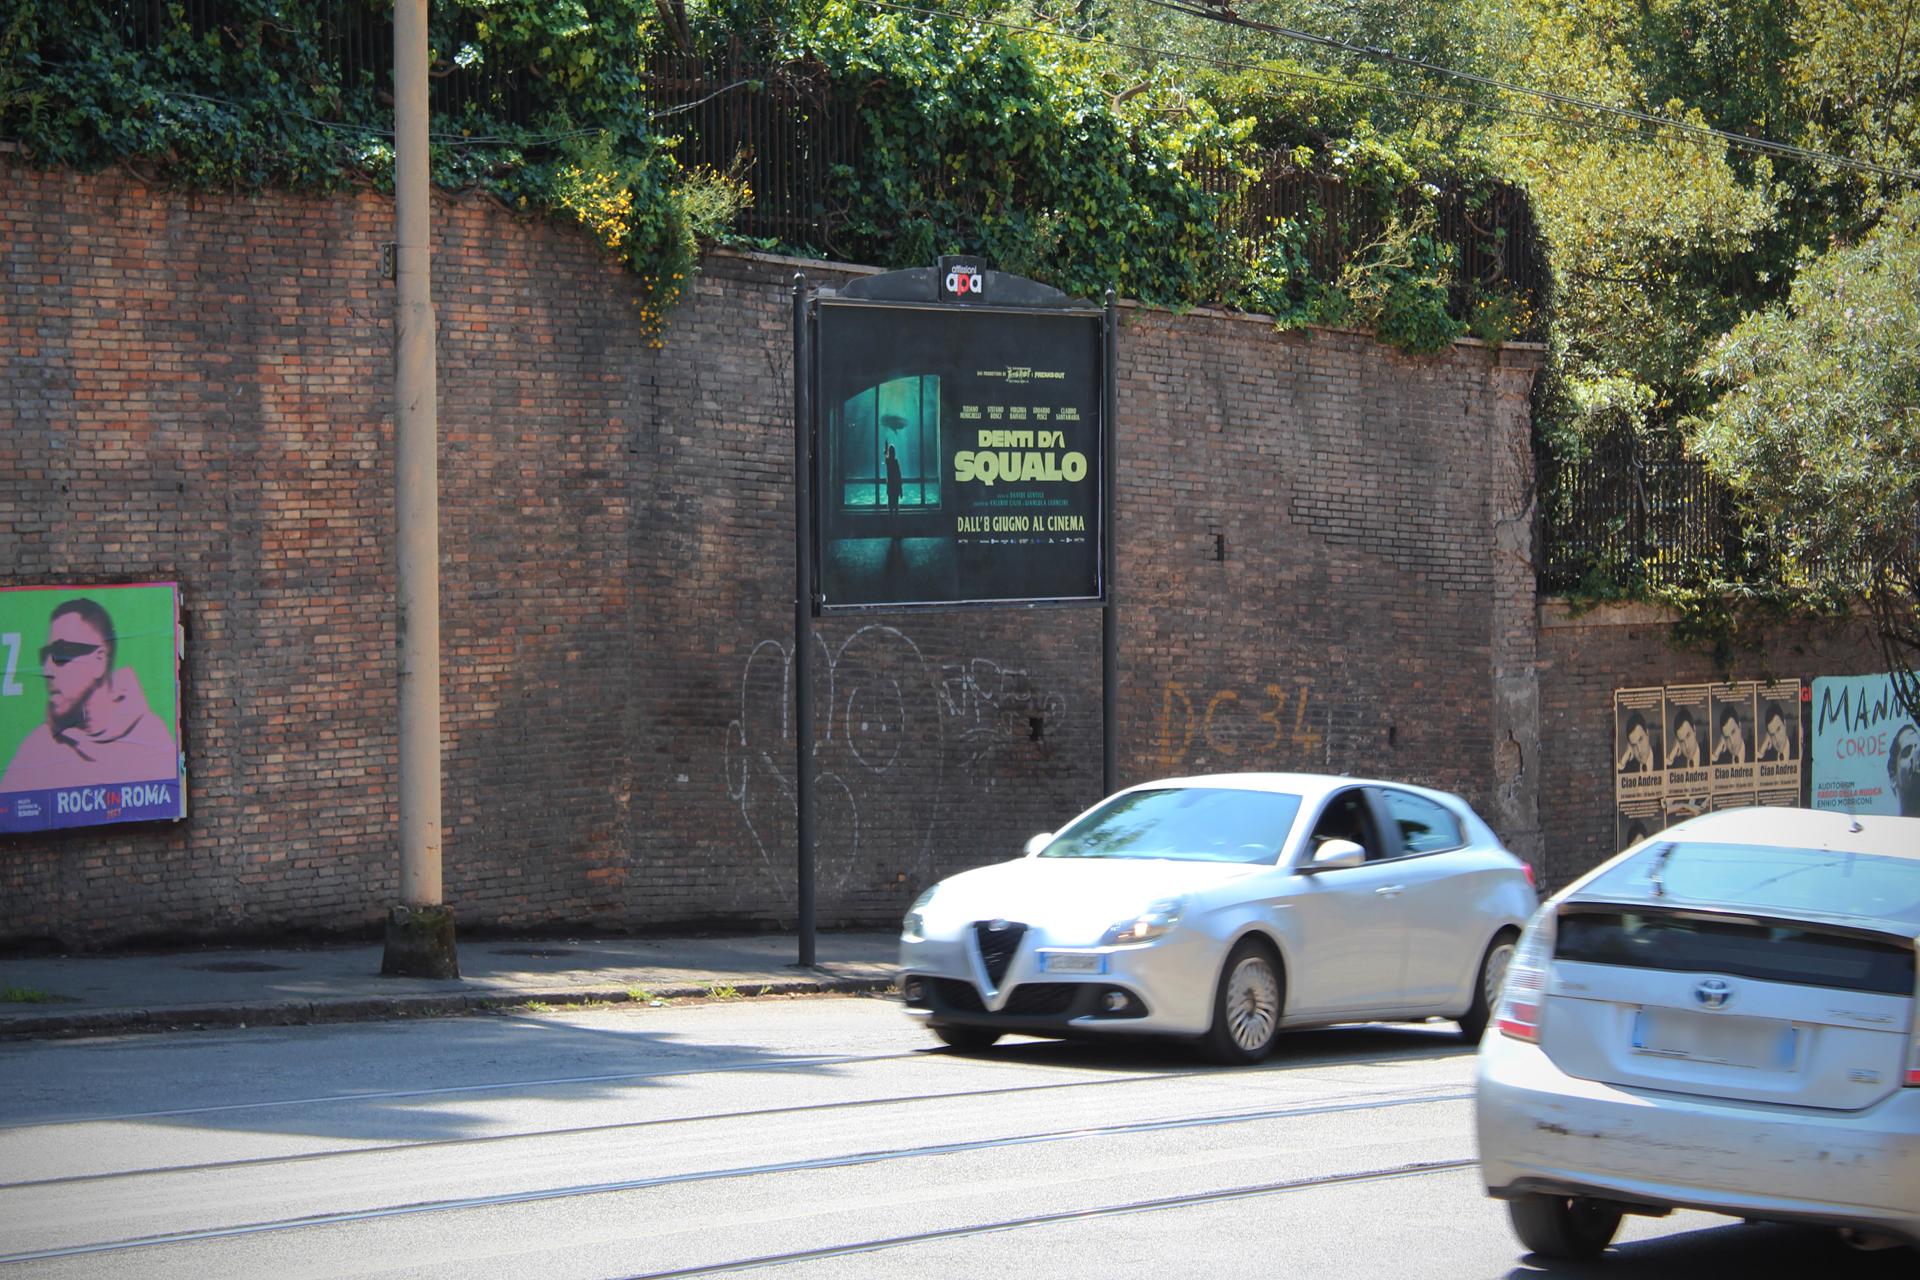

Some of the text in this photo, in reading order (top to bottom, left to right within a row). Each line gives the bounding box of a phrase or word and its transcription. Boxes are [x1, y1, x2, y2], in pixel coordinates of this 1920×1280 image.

[946, 272, 982, 296] apa
[978, 430, 1066, 448] DENTI DA
[954, 450, 1088, 486] SQUALO
[992, 516, 1030, 532] GIUGNO
[1032, 516, 1045, 531] AL
[1047, 515, 1085, 531] CINEMA
[1836, 733, 1887, 760] CORDE
[1669, 771, 1709, 784] Ciao Andrea
[1715, 766, 1754, 780] Ciao Andrea
[1760, 764, 1798, 777] Ciao Andrea
[1621, 776, 1662, 789] Ciao Andrea
[57, 787, 107, 814] ROCK
[121, 783, 172, 809] ROMA
[1817, 798, 1837, 808] ENNIO
